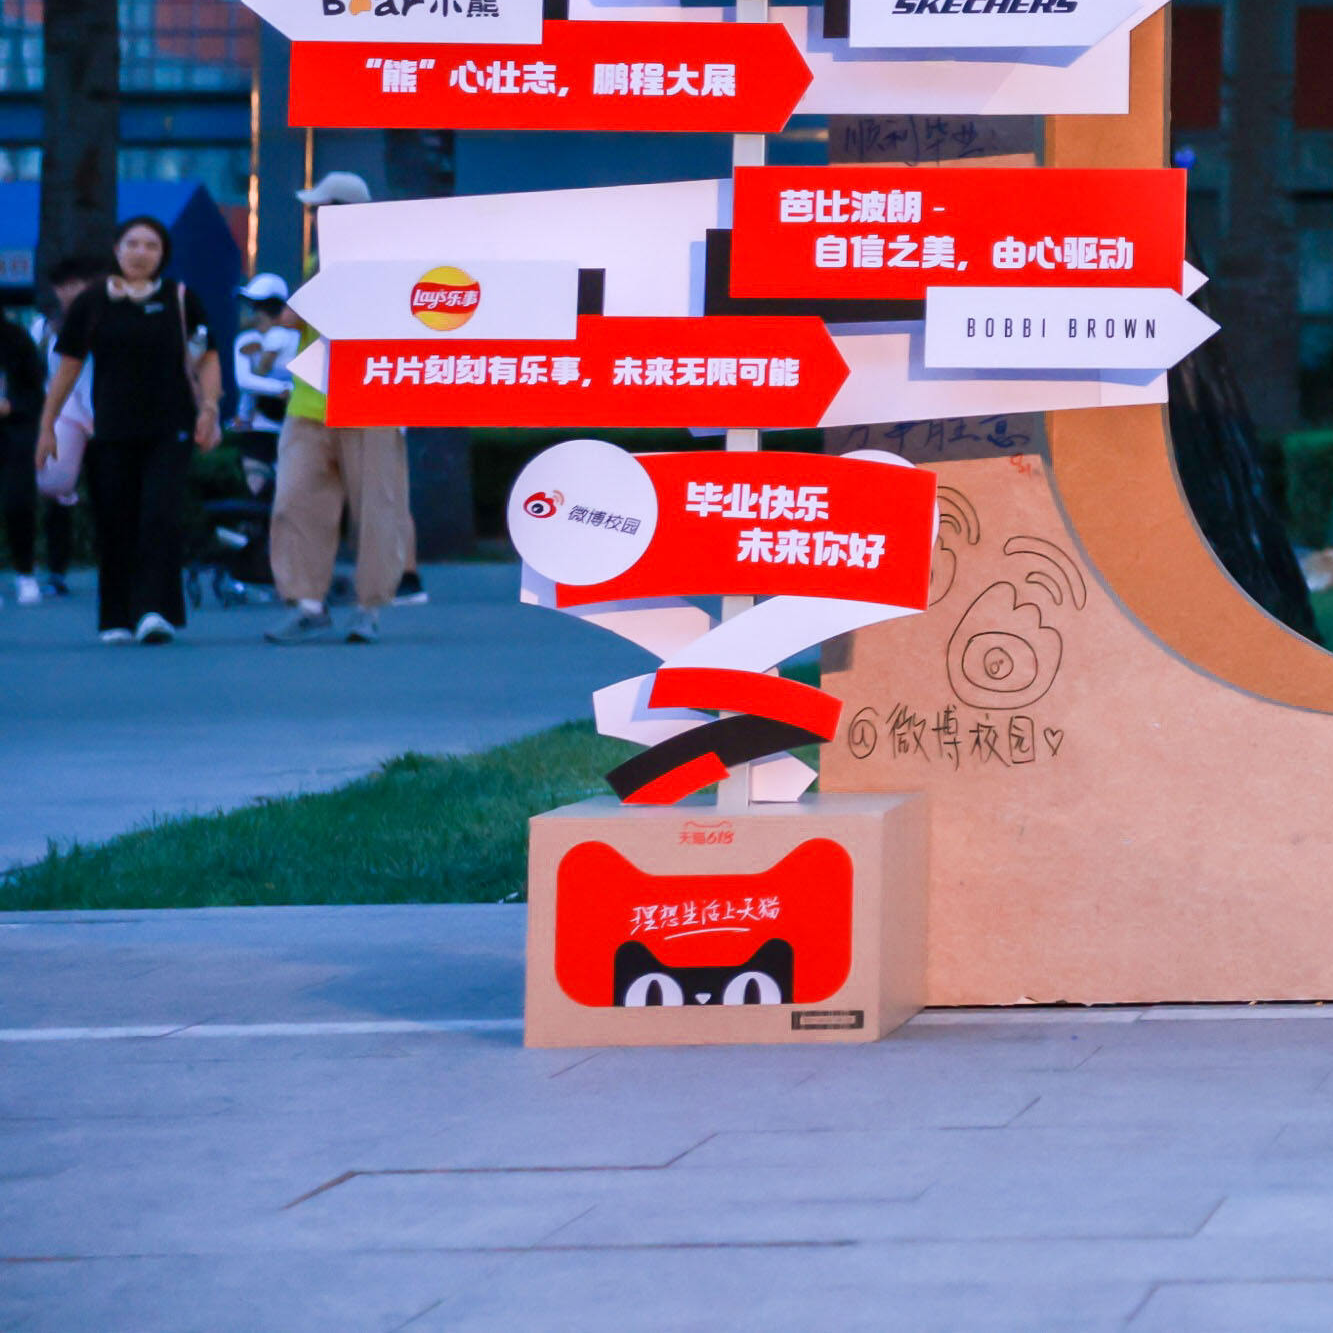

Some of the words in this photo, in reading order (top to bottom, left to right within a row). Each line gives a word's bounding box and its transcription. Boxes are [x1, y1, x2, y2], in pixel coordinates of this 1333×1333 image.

[779, 189, 923, 224] 芭比波朗
[966, 316, 1049, 341] BOBBI
[1068, 317, 1159, 341] BROWN
[685, 481, 829, 520] 毕业快乐
[567, 503, 643, 536] 微博校园
[736, 528, 886, 570] 未来你好
[679, 829, 735, 846] 天猫618
